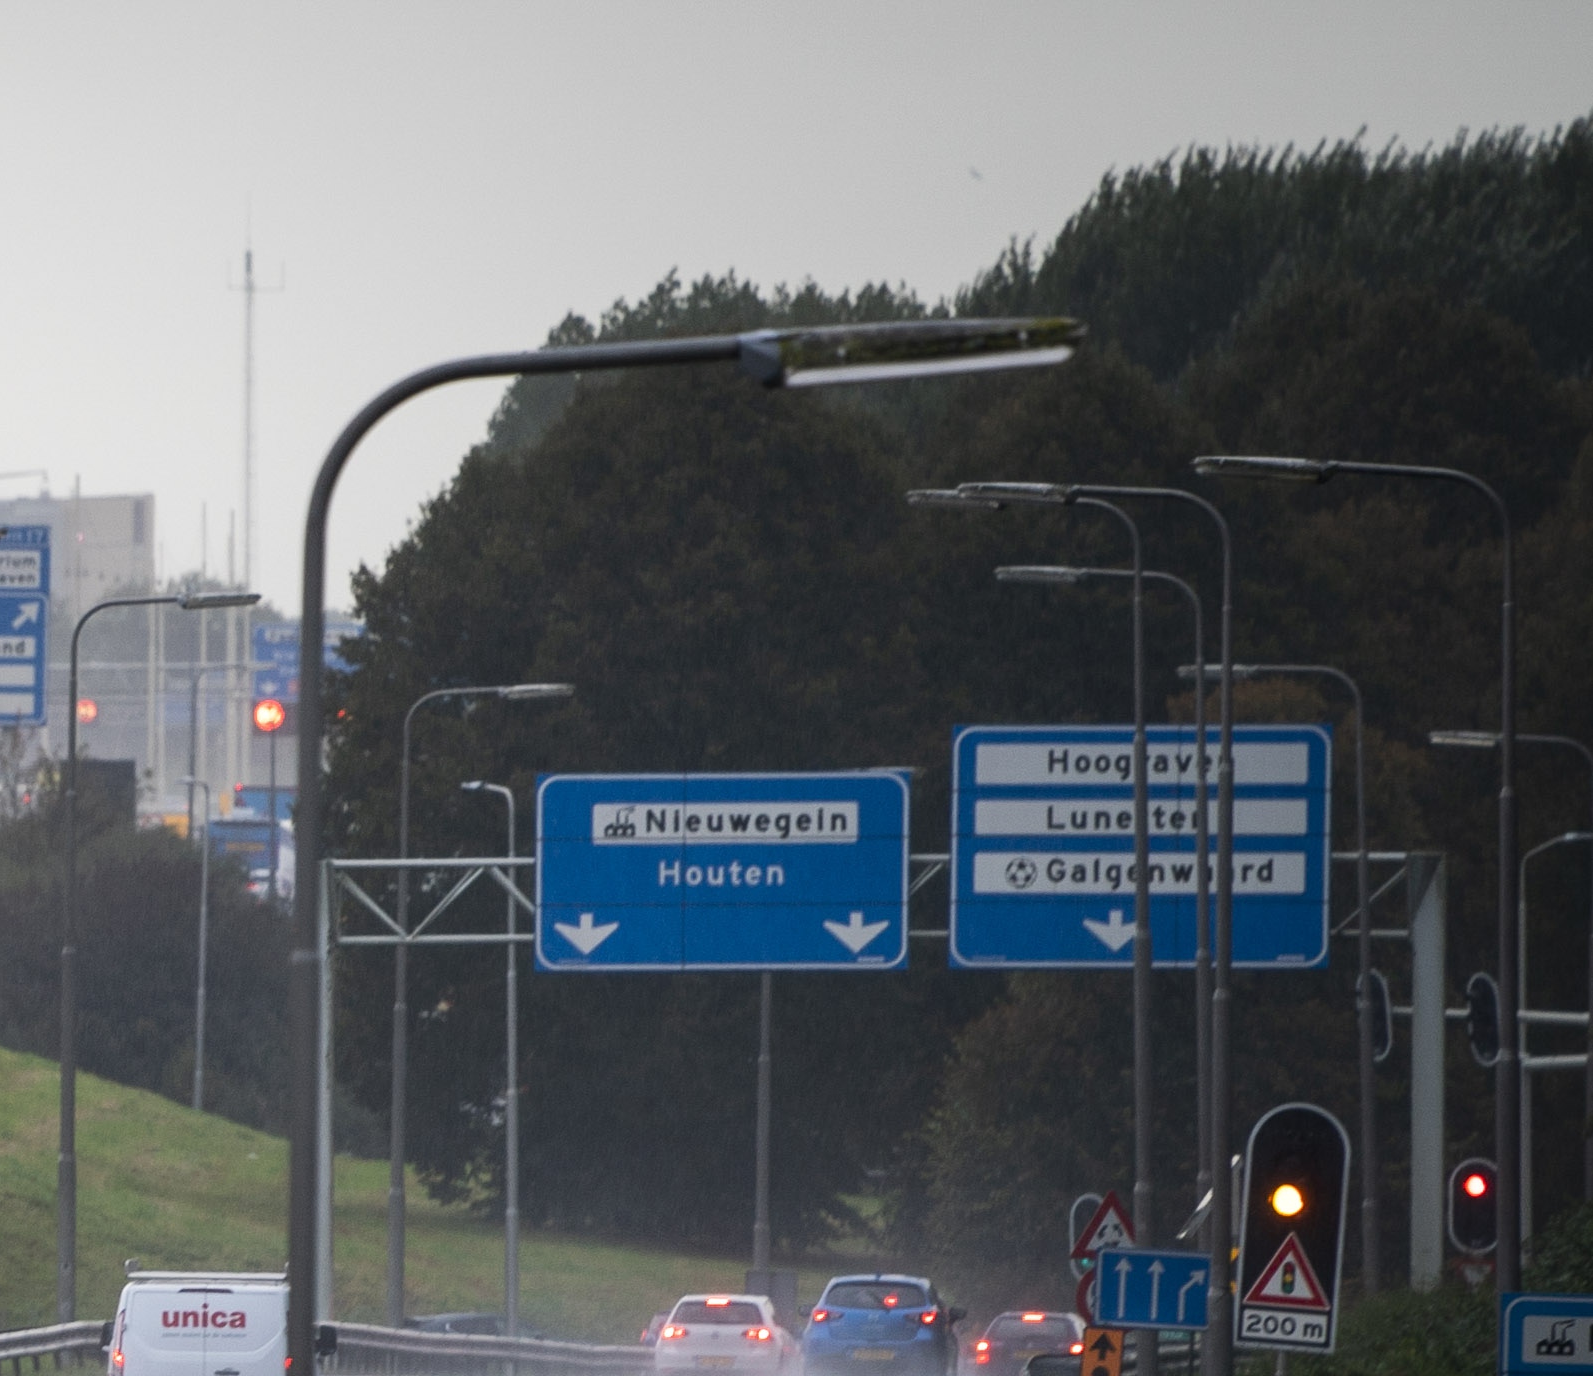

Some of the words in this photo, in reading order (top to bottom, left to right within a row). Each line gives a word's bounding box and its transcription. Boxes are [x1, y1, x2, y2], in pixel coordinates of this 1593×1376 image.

[644, 808, 848, 839] Nieuwegein
[658, 859, 785, 887] Houten
[1045, 857, 1274, 890] Galgenwrd
[161, 1302, 247, 1329] unica
[1245, 1312, 1296, 1337] 200
[1303, 1321, 1325, 1340] m
